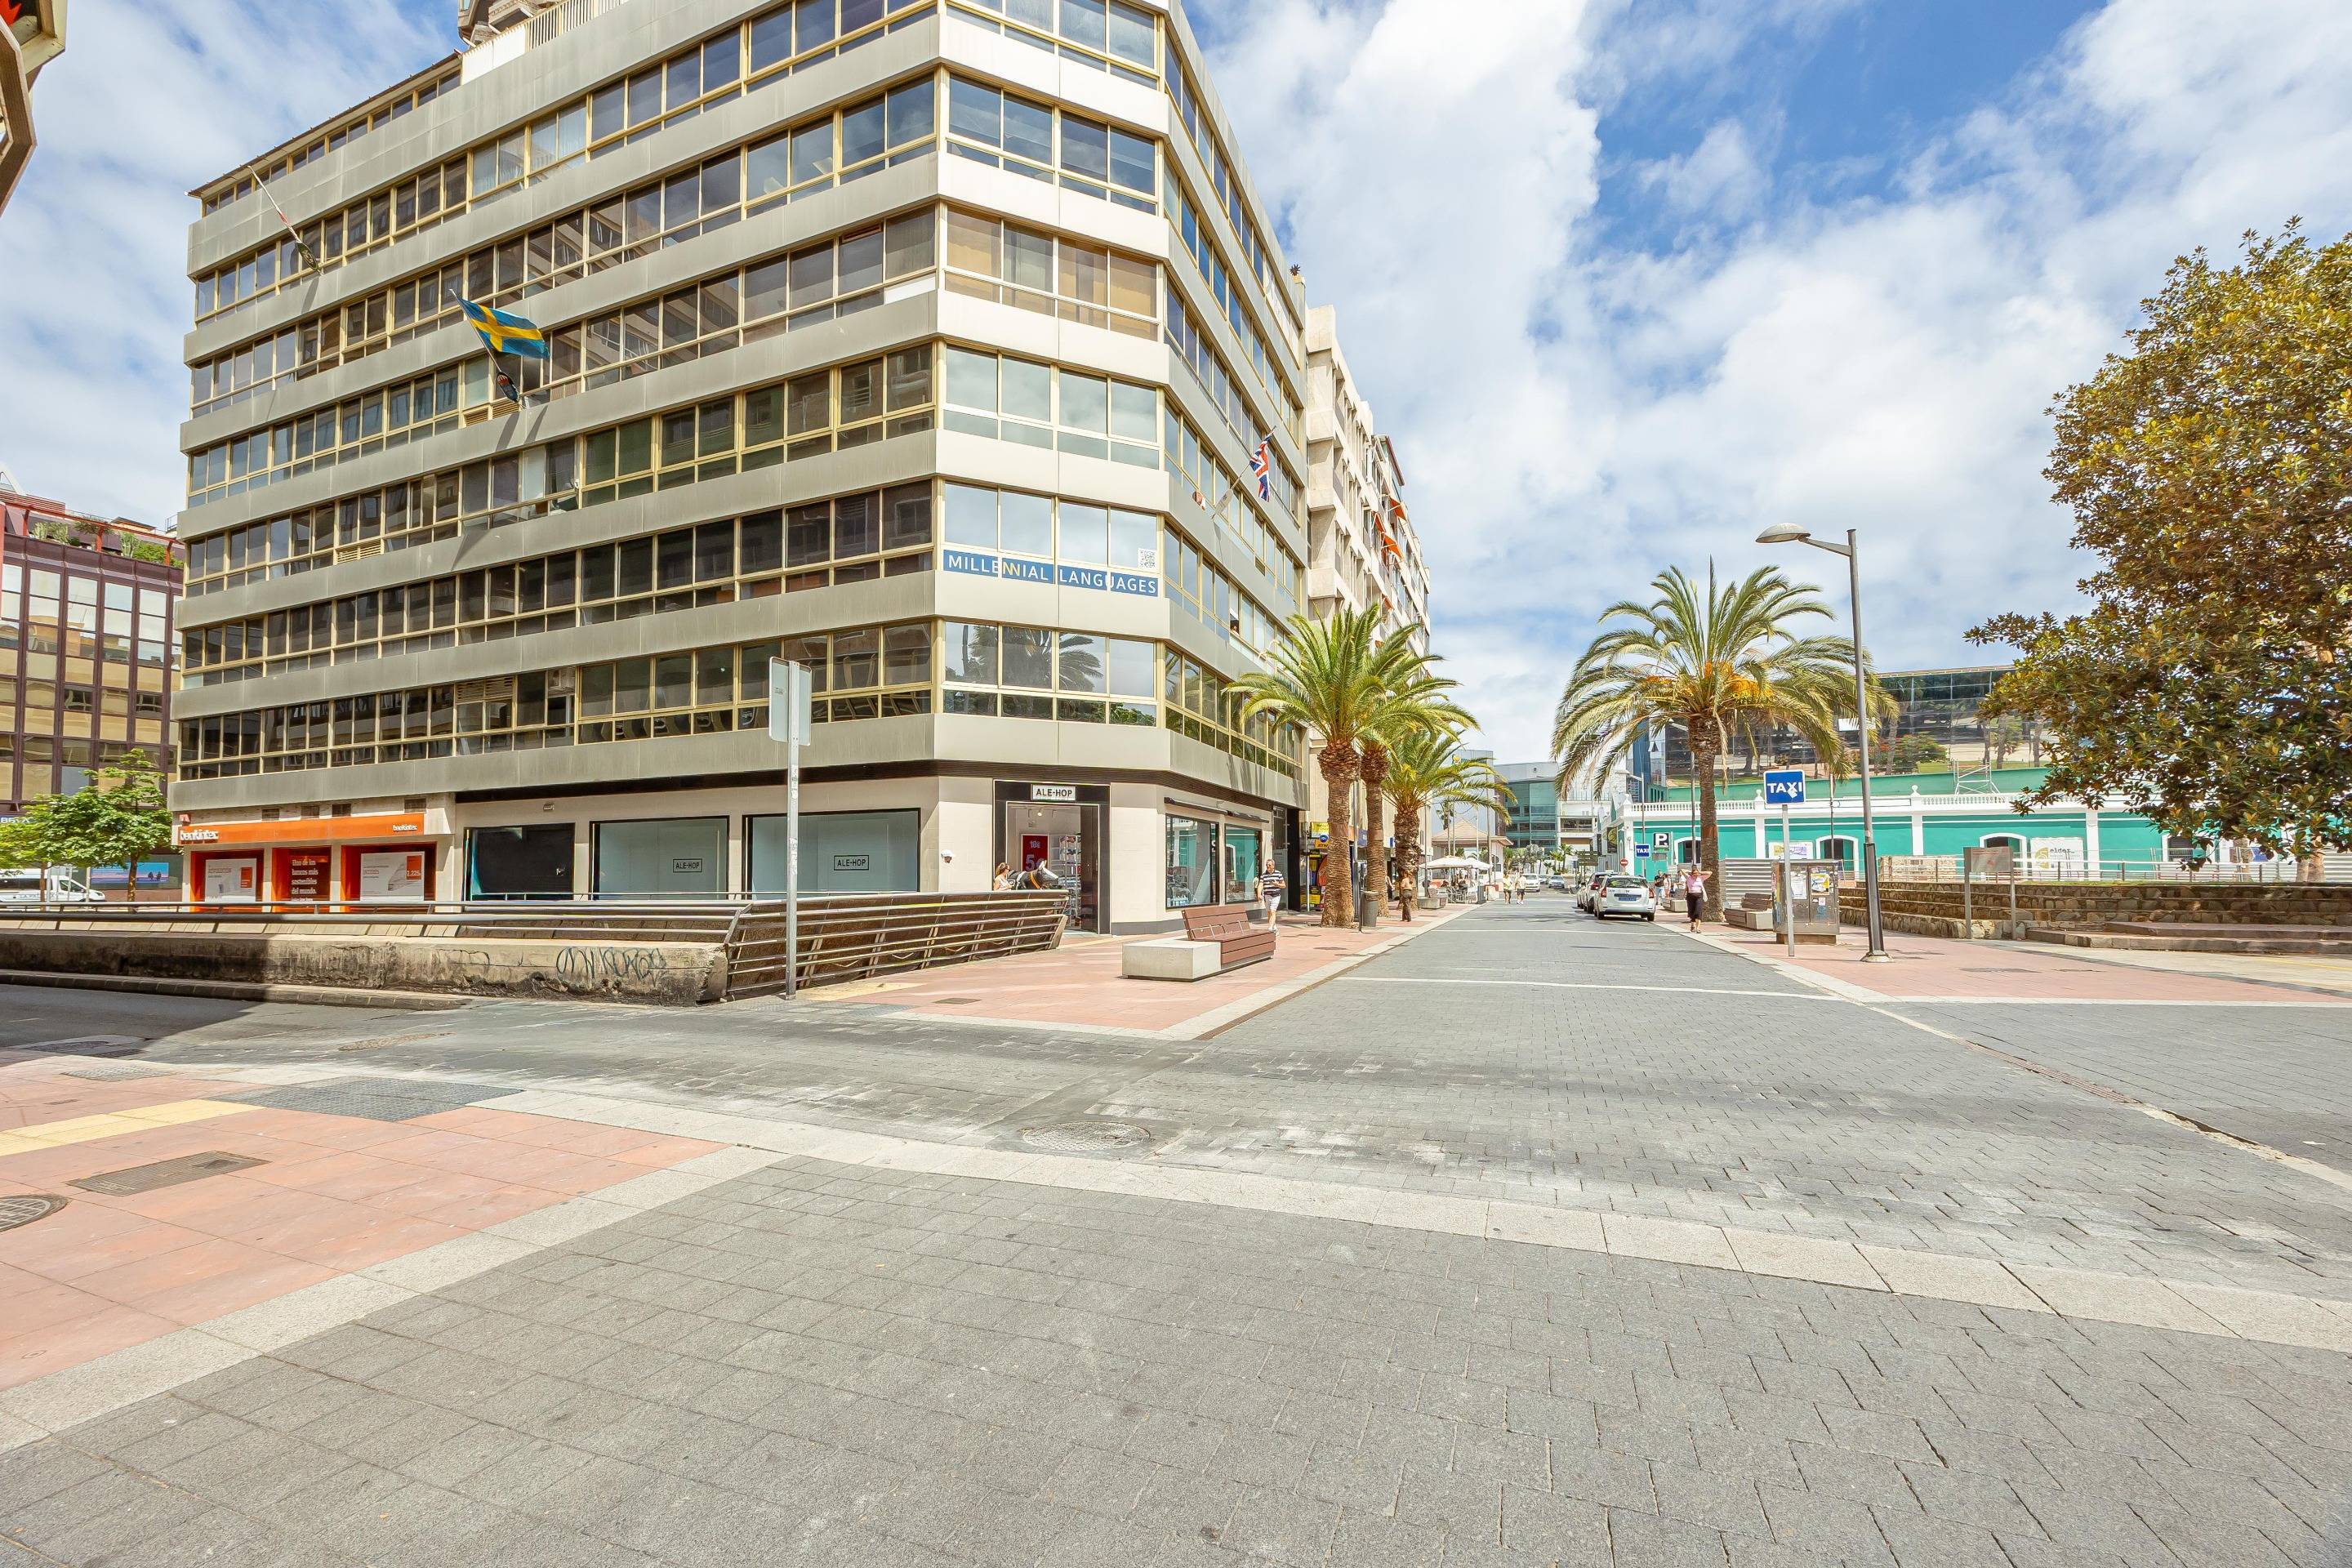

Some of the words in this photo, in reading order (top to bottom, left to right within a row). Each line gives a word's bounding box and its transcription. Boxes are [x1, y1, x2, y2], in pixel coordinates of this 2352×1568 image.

[948, 555, 1049, 581] MILLENNIAL
[1059, 568, 1156, 594] LANGUAGES
[1036, 788, 1072, 797] ALE-HOP
[1766, 782, 1802, 794] TAXI
[837, 859, 866, 867] ALE-HOP
